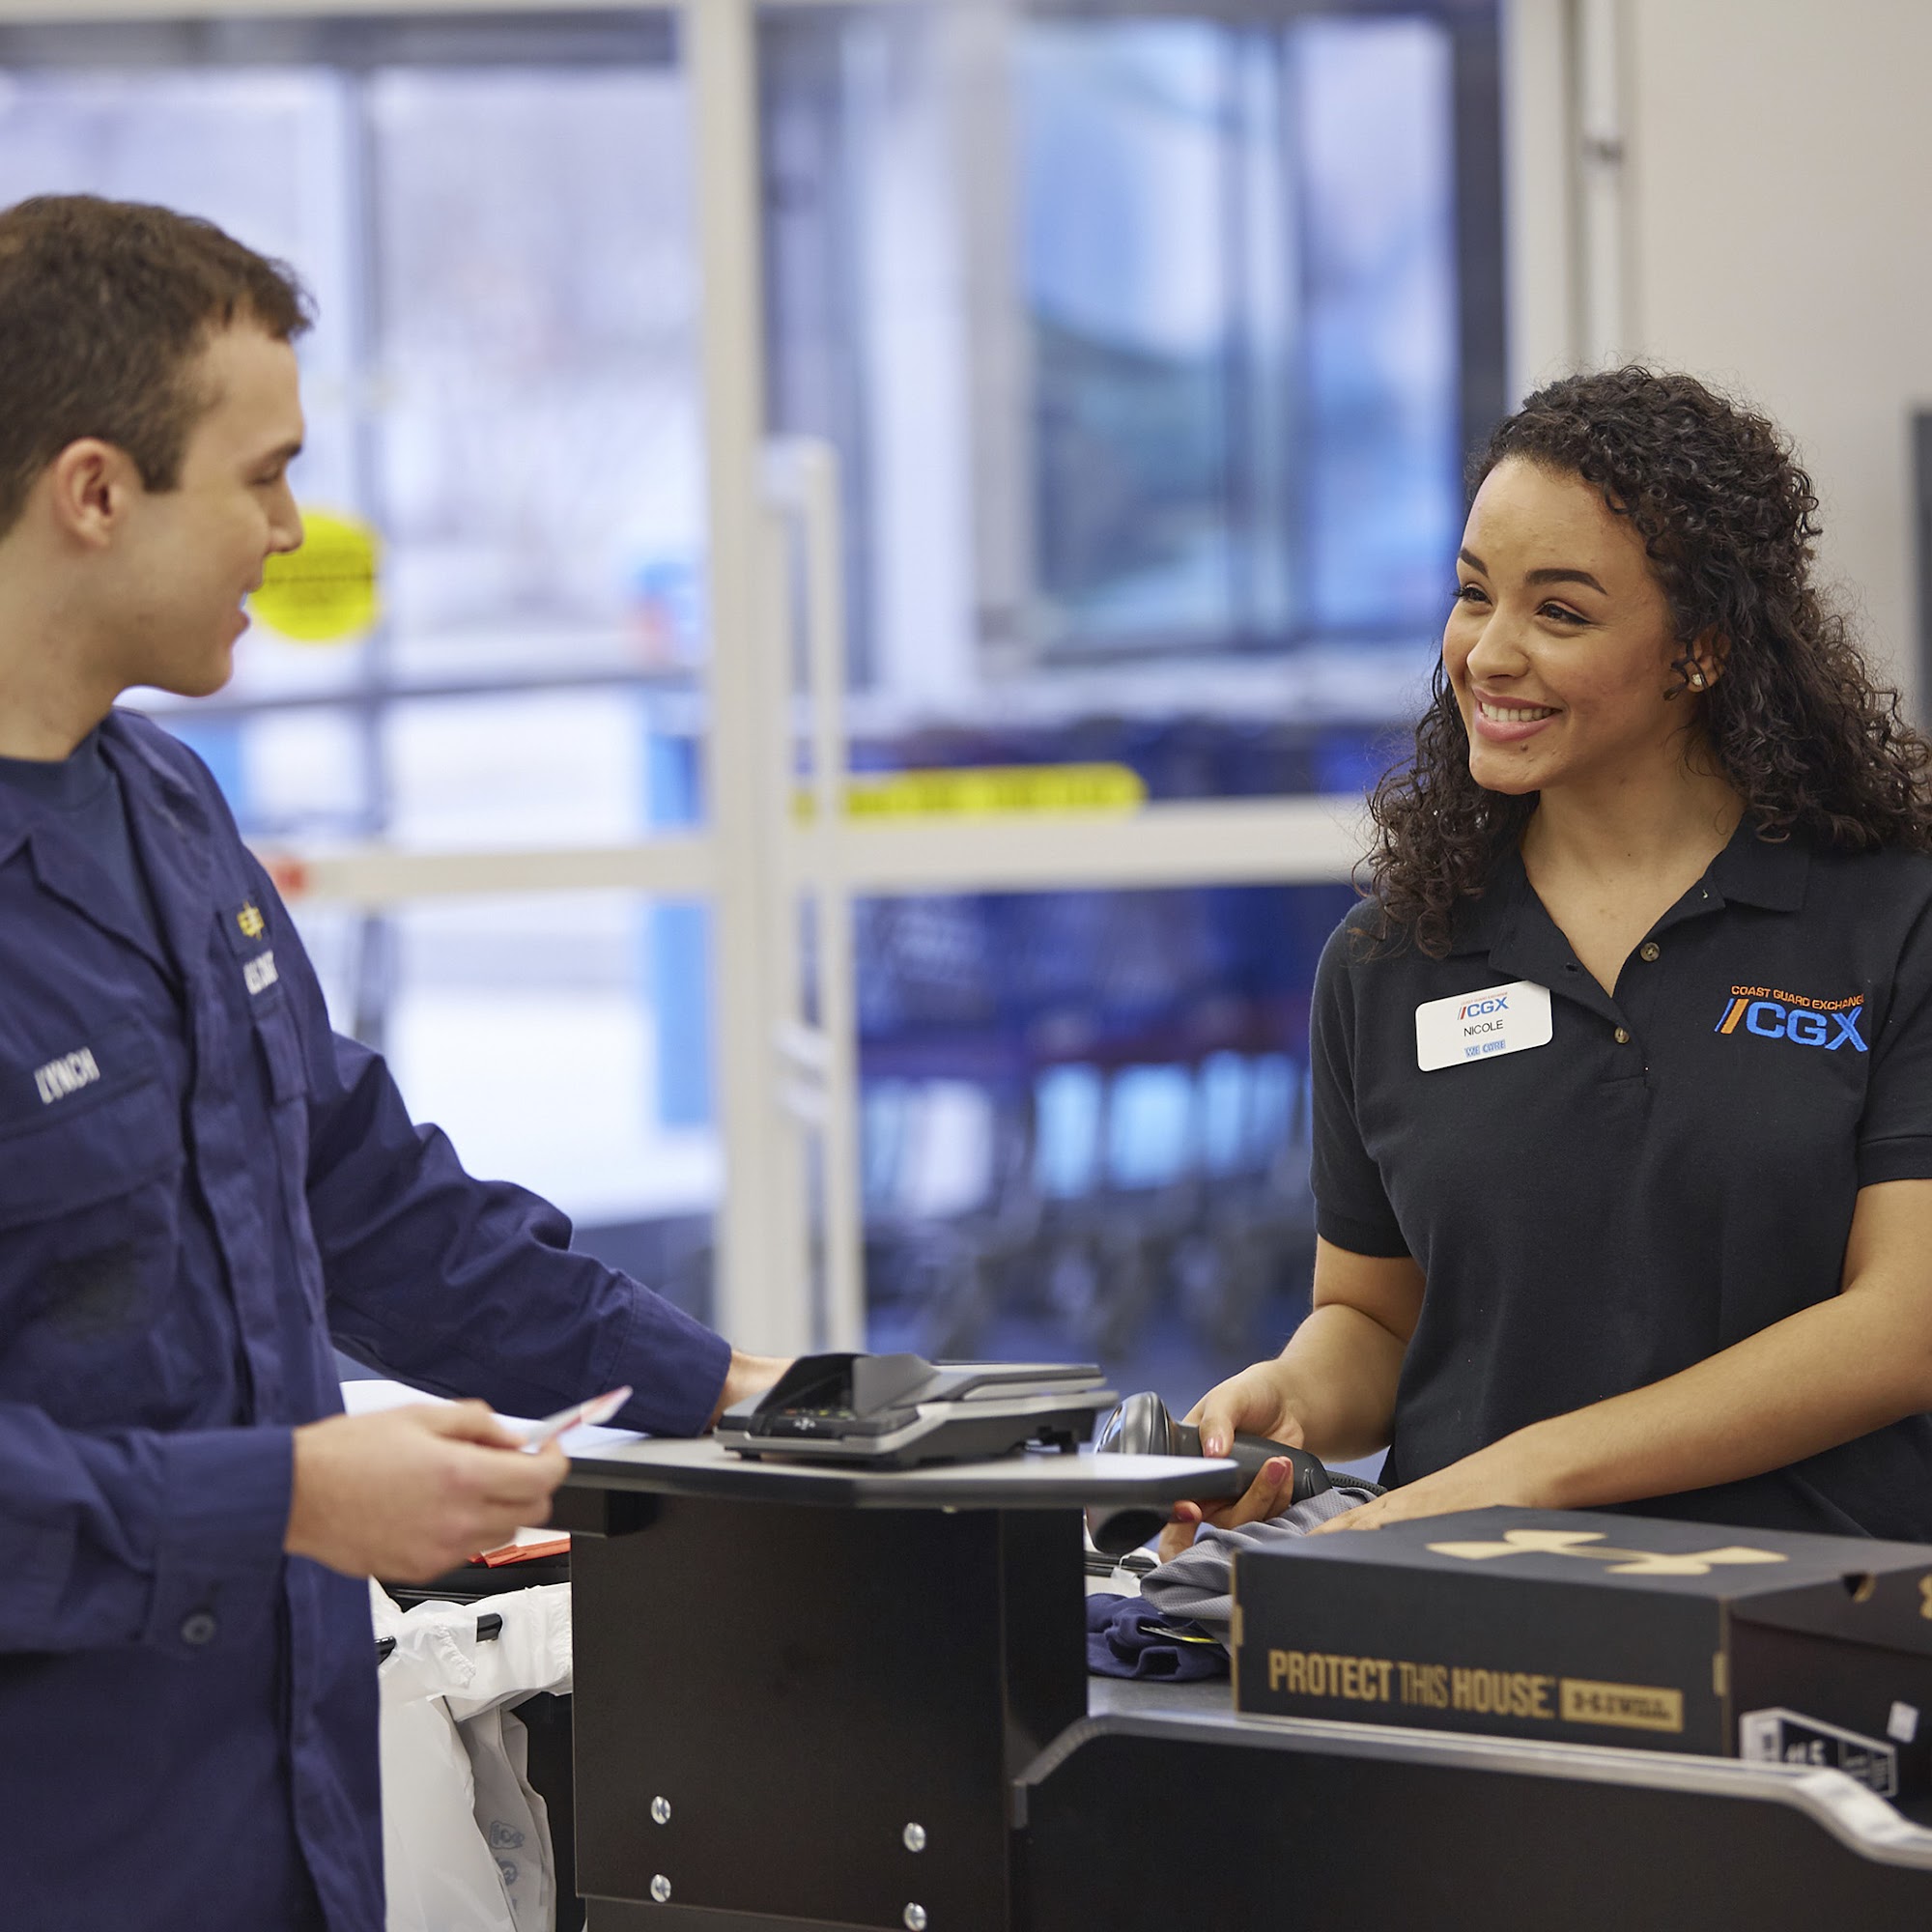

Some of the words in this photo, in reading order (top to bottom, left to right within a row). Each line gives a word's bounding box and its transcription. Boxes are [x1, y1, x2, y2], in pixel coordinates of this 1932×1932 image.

[1466, 997, 1509, 1017] CGX
[1731, 985, 1771, 998] COAST
[1773, 989, 1810, 1007] GUARD
[1811, 993, 1864, 1010] EXCHANG
[1463, 1019, 1503, 1037] NICOLE
[1746, 1006, 1868, 1052] CGX
[1268, 1649, 1394, 1702] PROTECT
[1398, 1661, 1448, 1709] THIS
